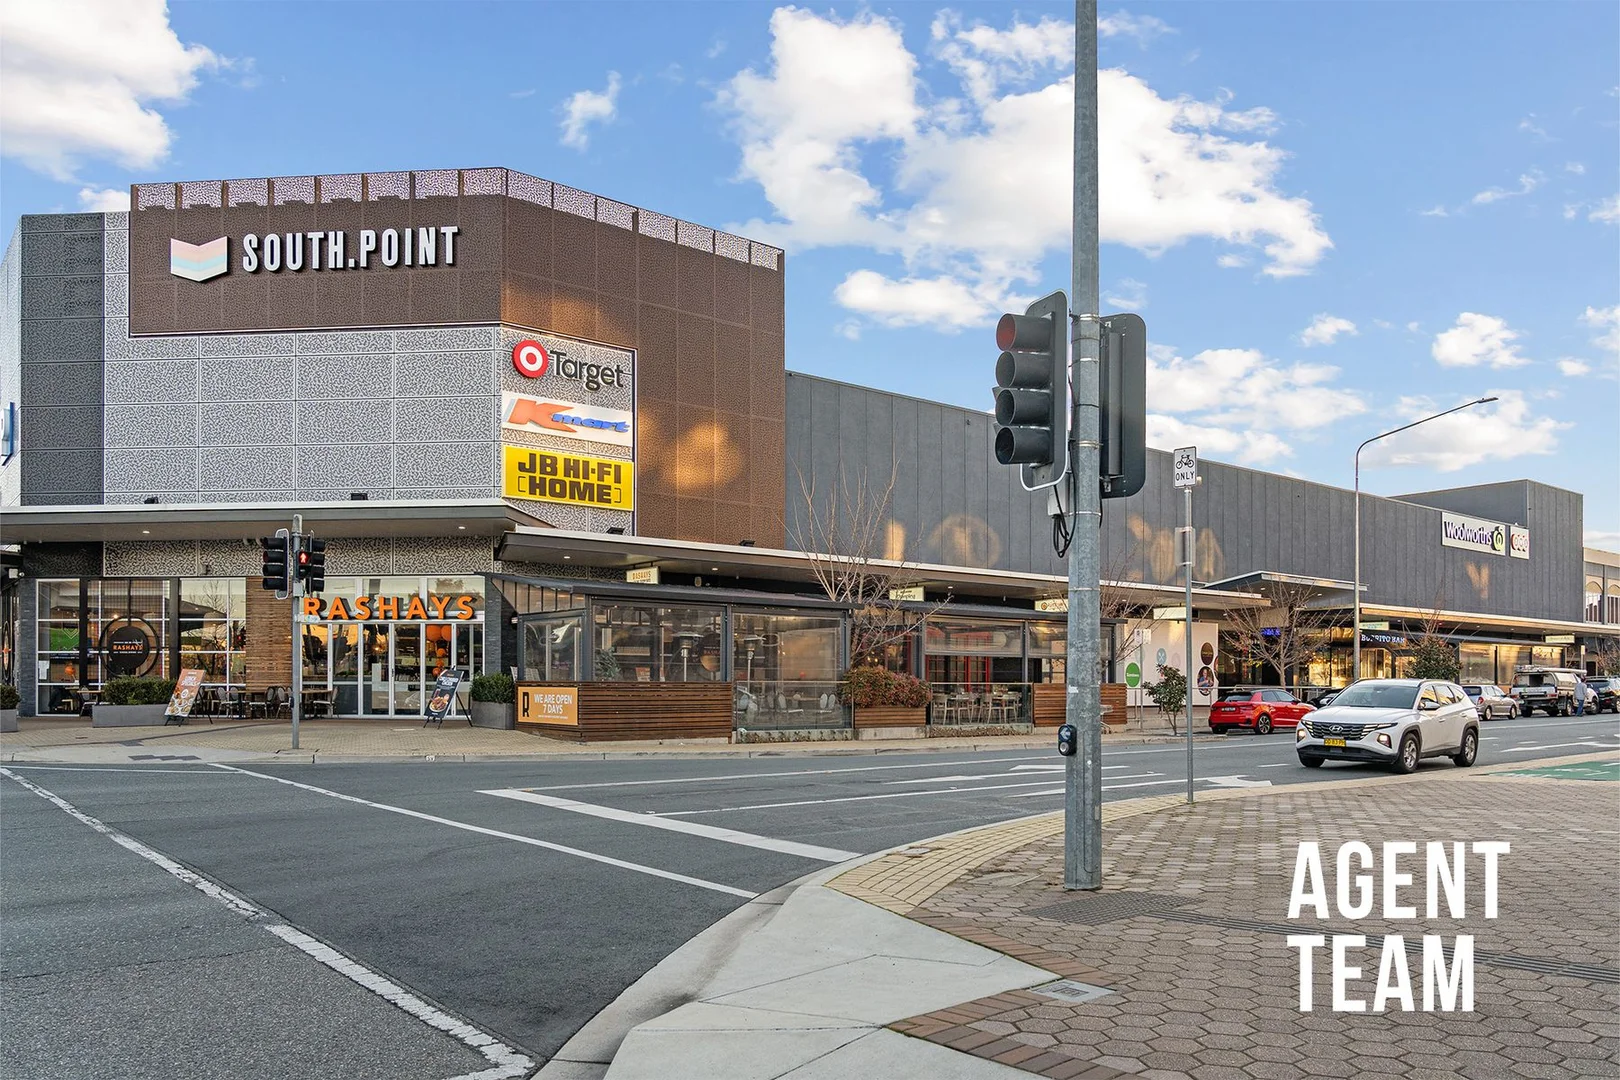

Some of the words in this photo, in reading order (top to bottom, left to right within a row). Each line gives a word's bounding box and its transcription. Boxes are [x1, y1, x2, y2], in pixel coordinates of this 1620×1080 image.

[242, 226, 459, 273] SOUTH.POINT
[549, 350, 624, 391] Target
[508, 398, 630, 433] Kmart
[518, 453, 558, 476] JB
[1175, 471, 1195, 481] ONLY
[528, 475, 612, 504] HOME
[1444, 521, 1492, 545] Woolworths
[304, 595, 476, 621] RASHAYS
[522, 691, 530, 717] R
[534, 694, 544, 703] WE
[544, 694, 555, 704] ARE
[555, 694, 573, 705] OPEN
[543, 704, 547, 713] 7
[547, 704, 563, 714] DAYS
